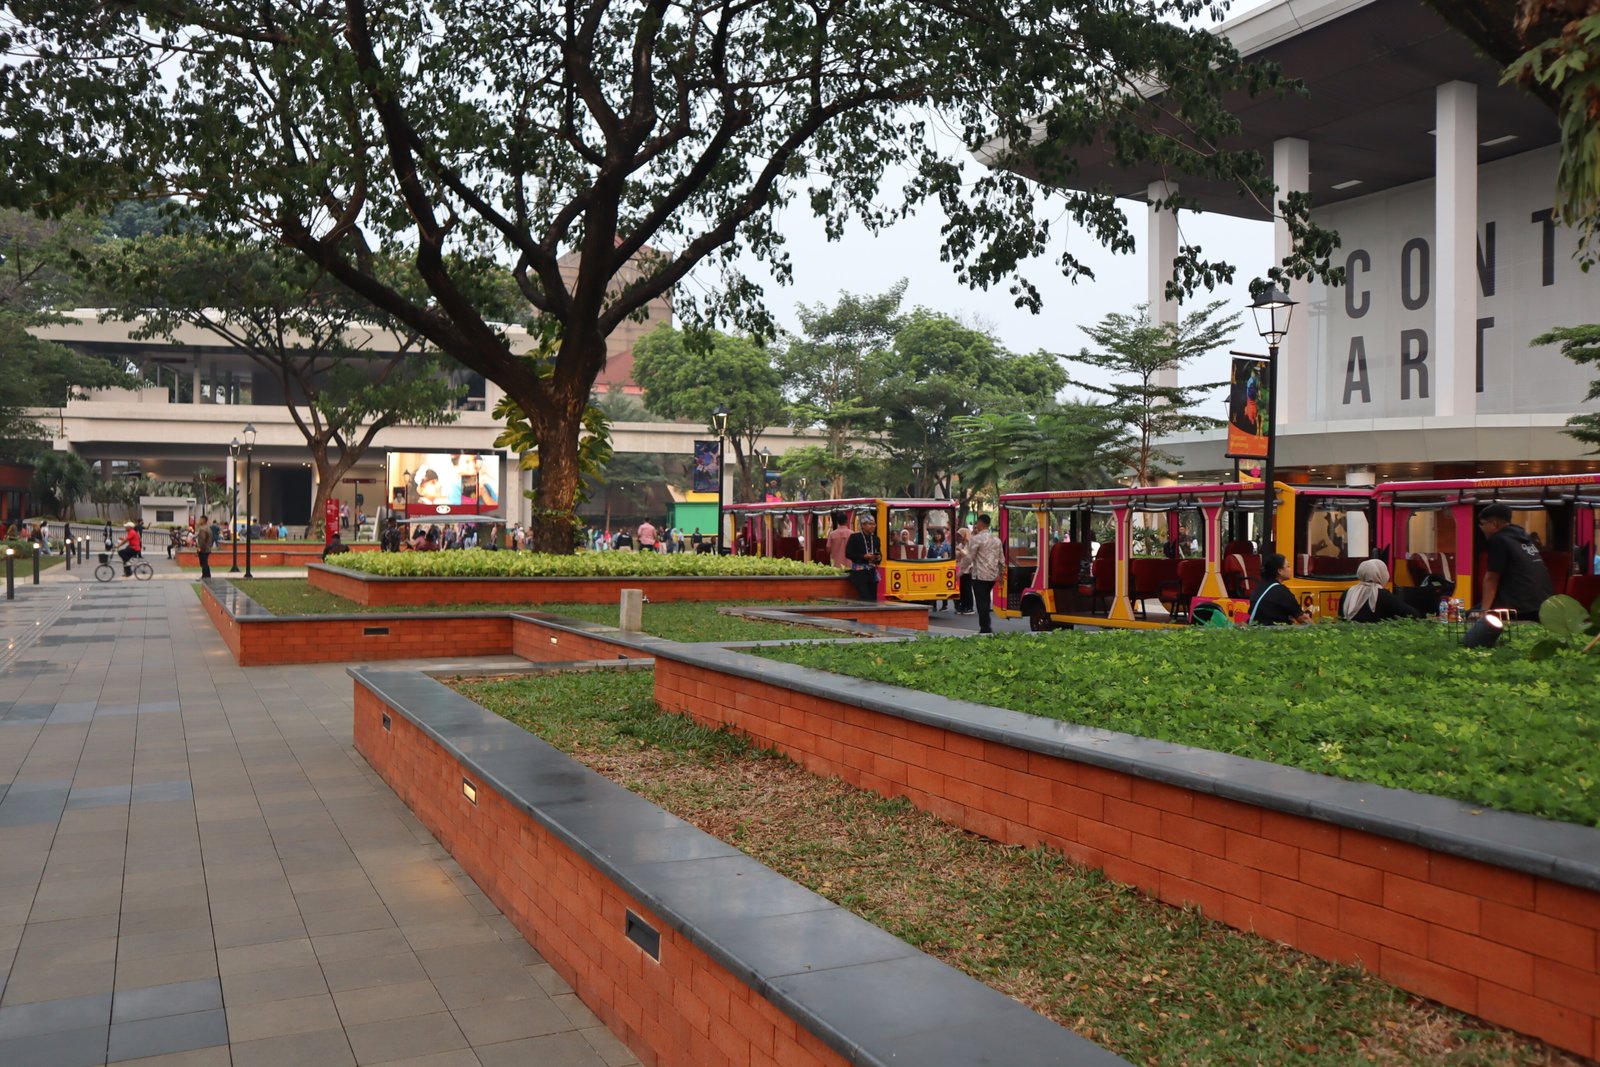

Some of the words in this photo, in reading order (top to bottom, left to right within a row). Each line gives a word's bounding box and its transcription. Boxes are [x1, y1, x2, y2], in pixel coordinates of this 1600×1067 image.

[1342, 316, 1495, 405] ART
[1474, 480, 1502, 488] TAMAN
[1505, 478, 1541, 487] JELAJAH
[1544, 476, 1595, 486] INDONESIA
